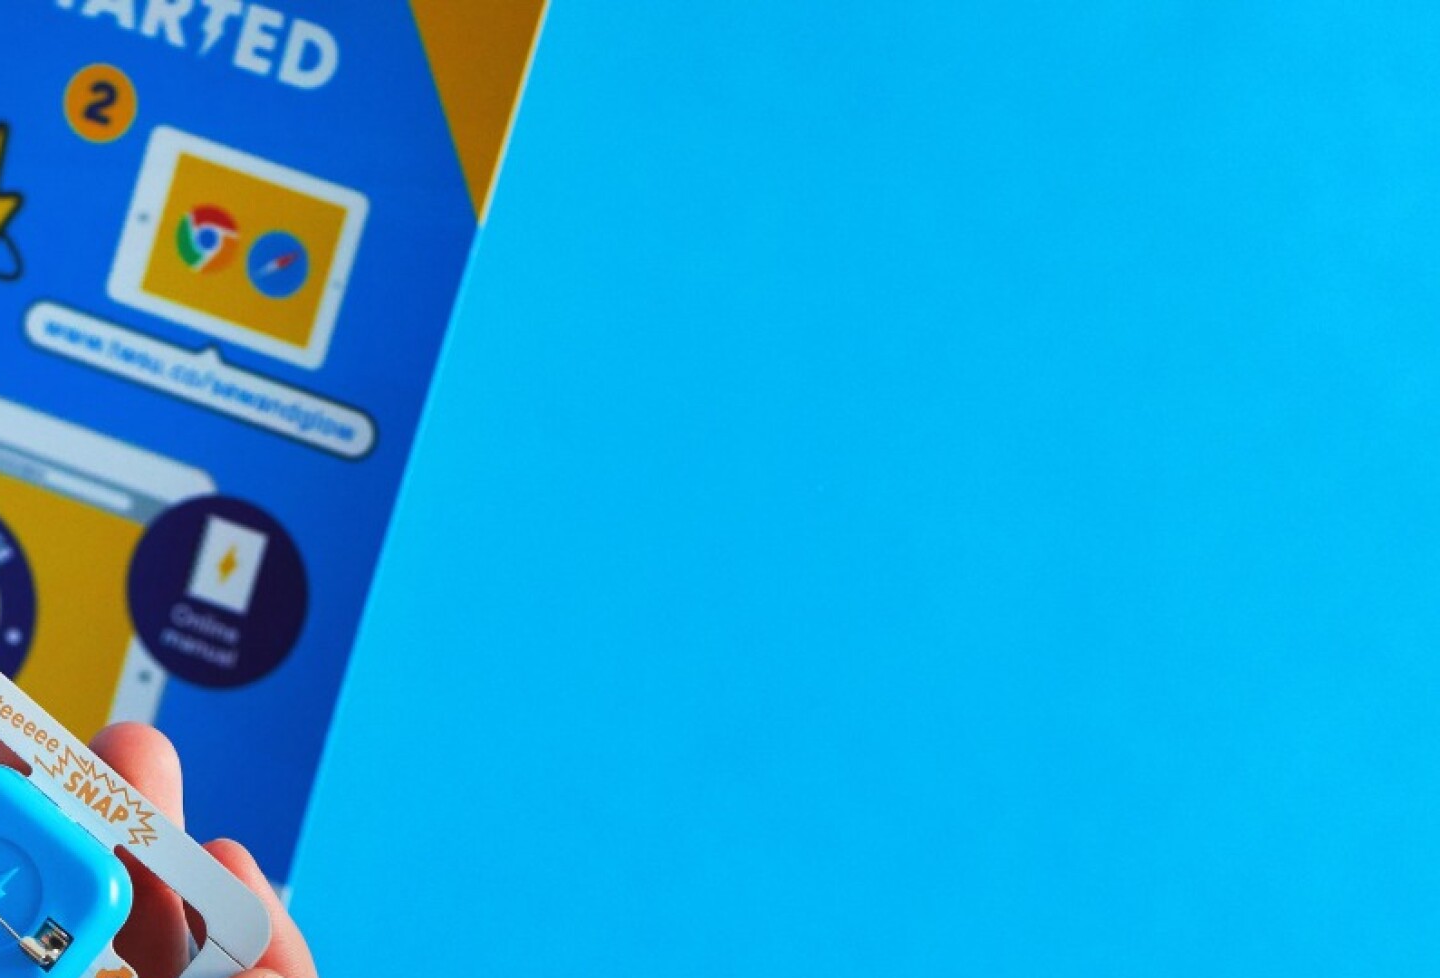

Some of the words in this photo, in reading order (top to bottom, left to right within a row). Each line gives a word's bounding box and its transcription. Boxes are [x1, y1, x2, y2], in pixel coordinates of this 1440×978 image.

[82, 80, 118, 126] 2
[169, 603, 240, 646] Online
[159, 627, 238, 670] manual
[62, 770, 130, 824] SNAP
